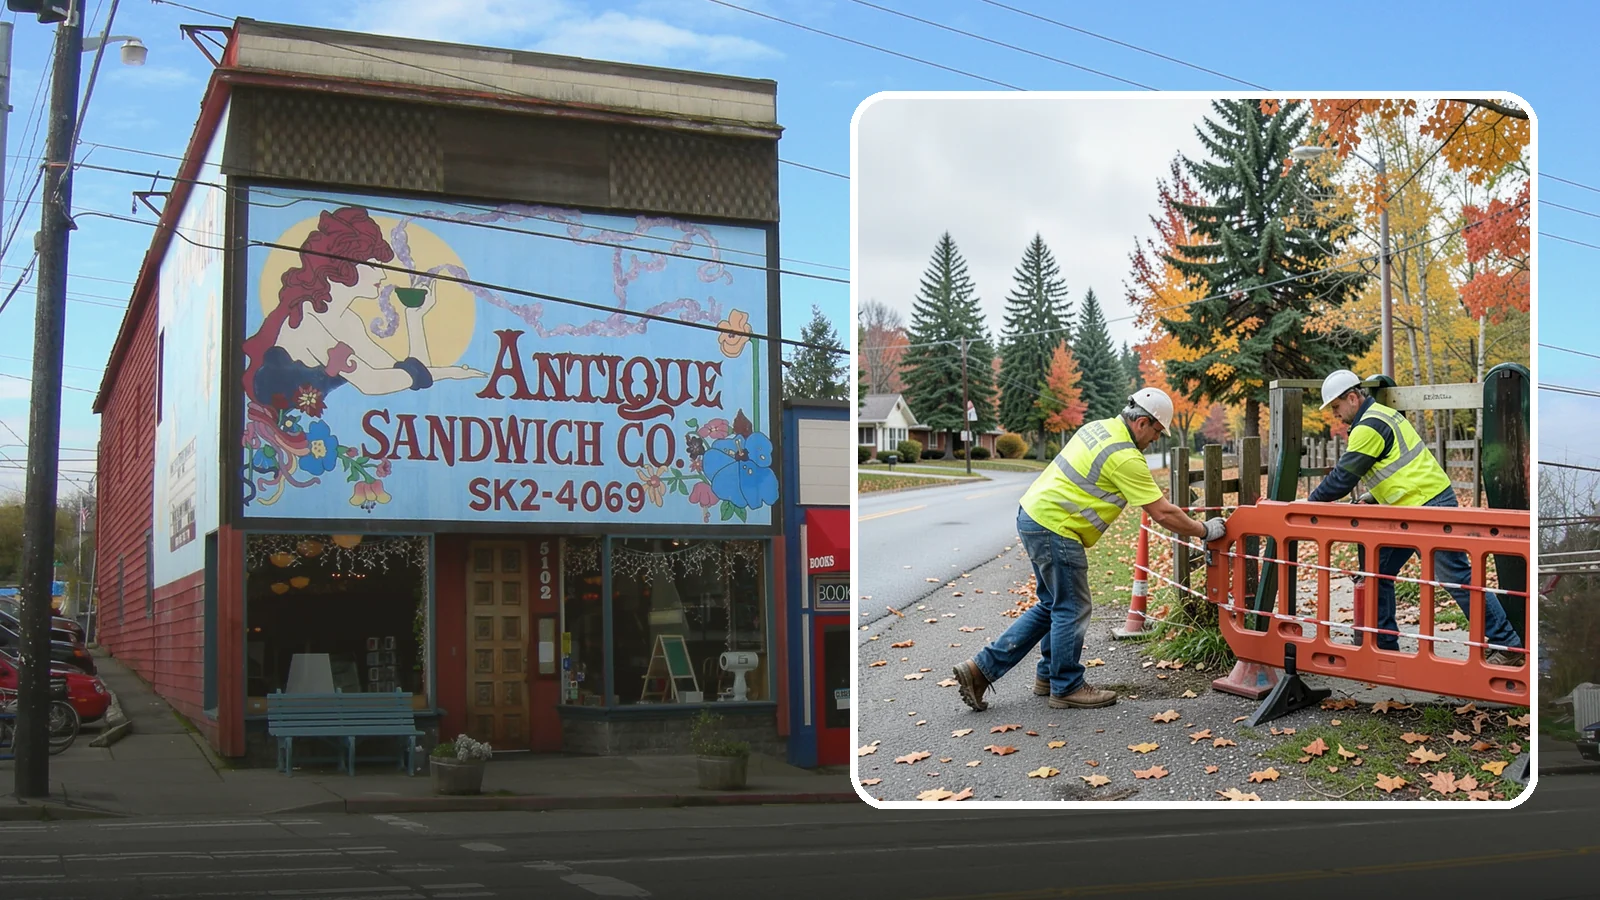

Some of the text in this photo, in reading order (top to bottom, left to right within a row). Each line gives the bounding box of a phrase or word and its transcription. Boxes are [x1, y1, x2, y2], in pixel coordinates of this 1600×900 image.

[476, 329, 723, 421] ANTIQUE
[361, 409, 685, 469] SANDWICH CO.
[468, 477, 645, 513] SK2-4069
[540, 541, 551, 600] 5102
[809, 555, 835, 569] BOOKS
